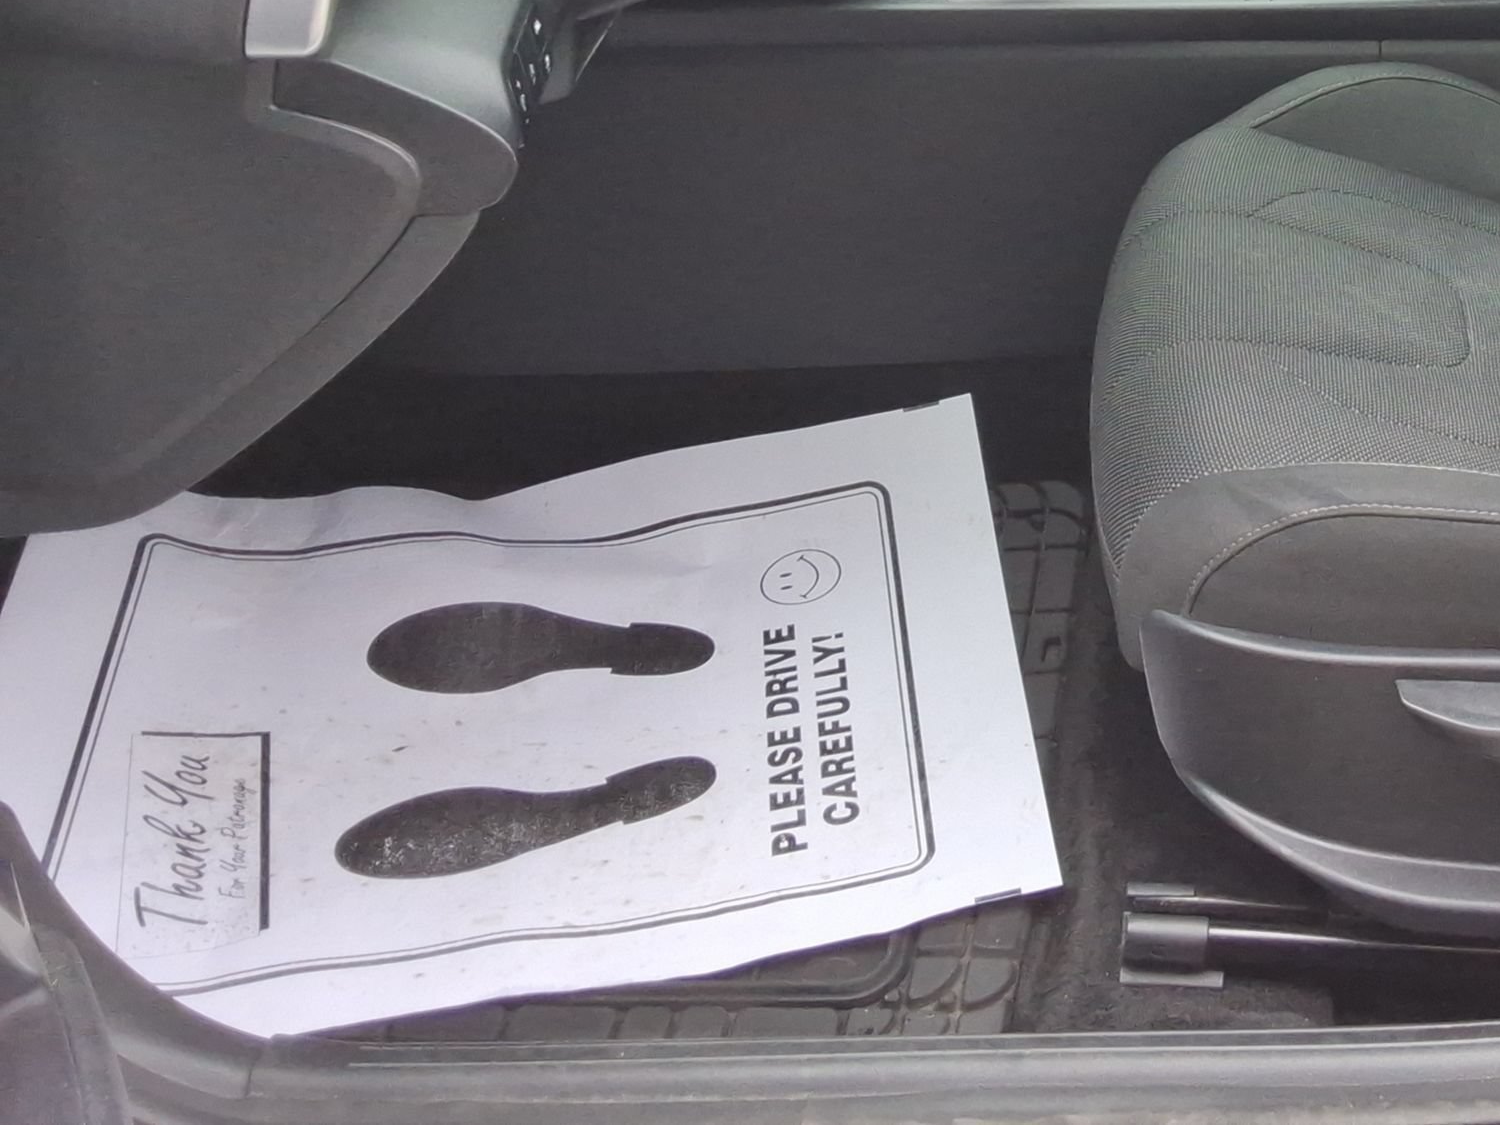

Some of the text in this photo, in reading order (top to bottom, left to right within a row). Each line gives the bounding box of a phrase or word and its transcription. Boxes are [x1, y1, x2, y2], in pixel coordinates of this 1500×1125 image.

[763, 624, 808, 856] PLEASE DRIVE
[812, 632, 860, 826] CAREFULLY!
[134, 755, 214, 927] Thank You
[218, 778, 256, 899] For Your Patronage
